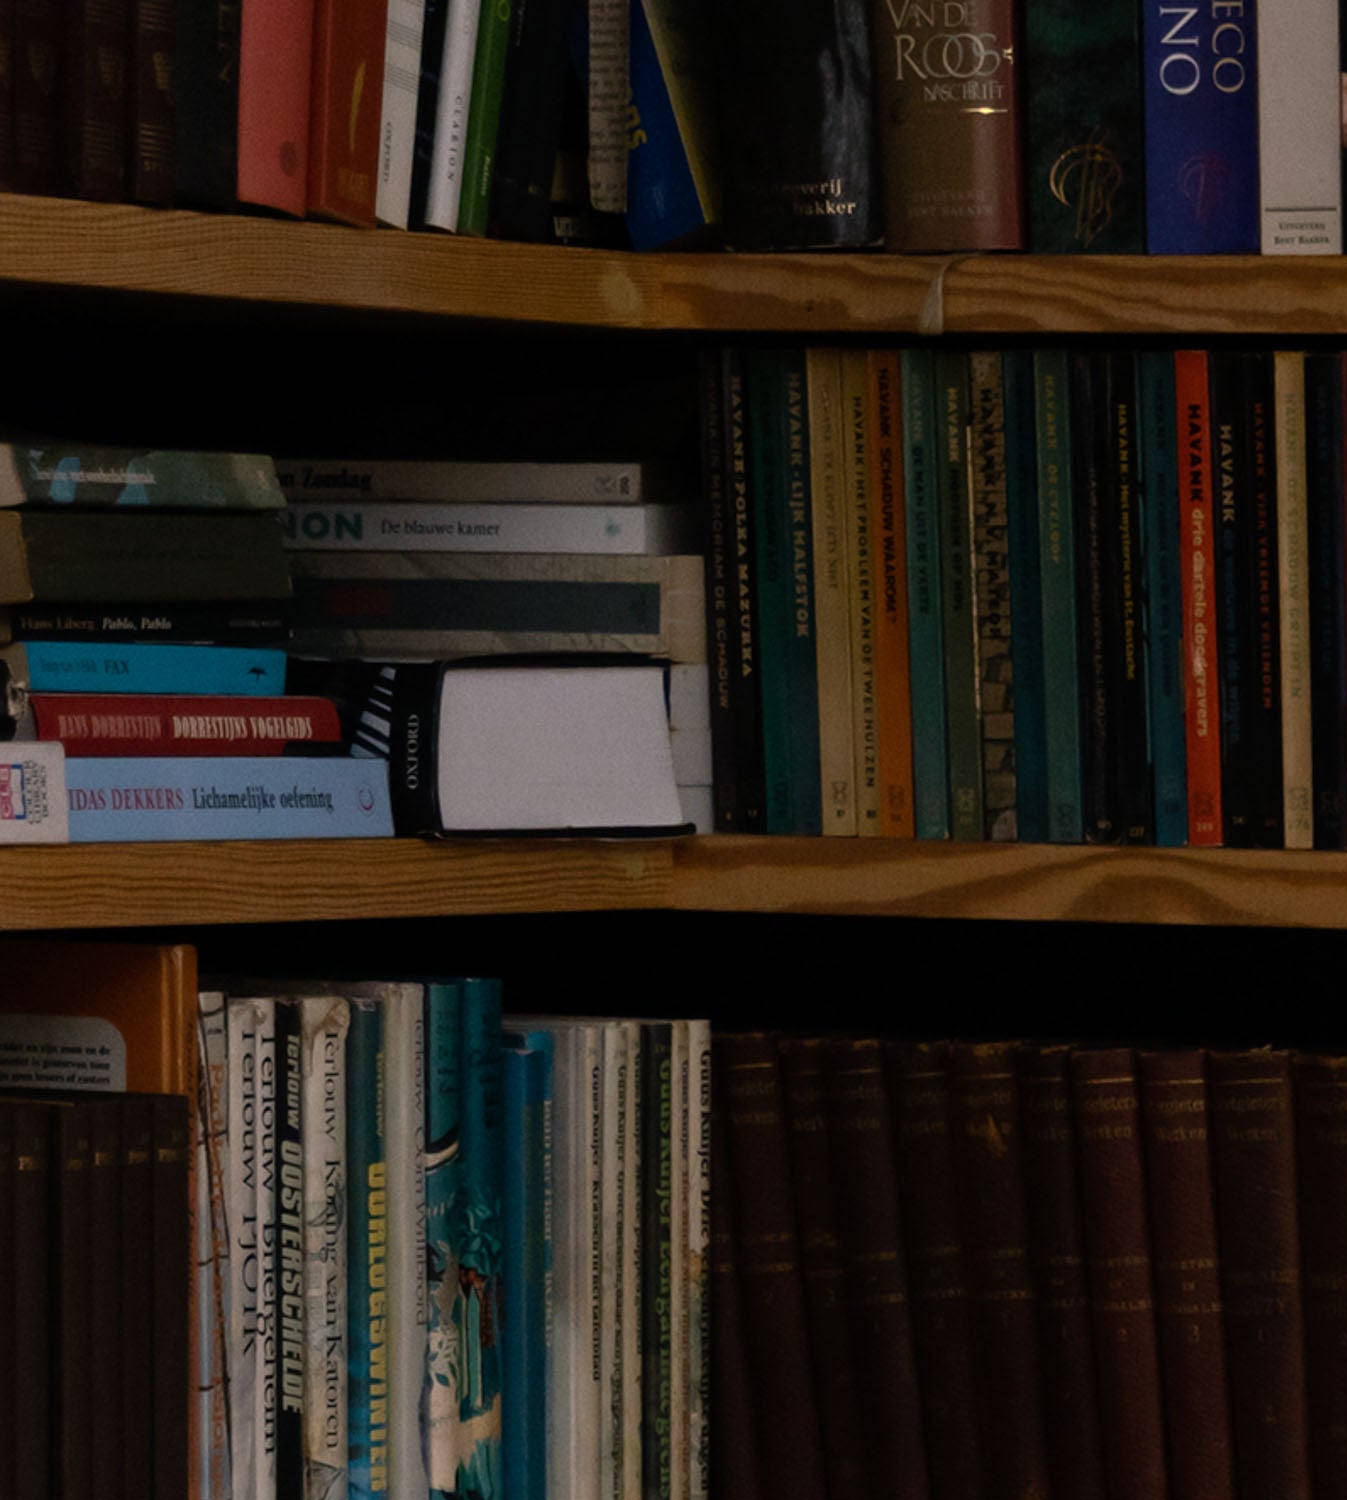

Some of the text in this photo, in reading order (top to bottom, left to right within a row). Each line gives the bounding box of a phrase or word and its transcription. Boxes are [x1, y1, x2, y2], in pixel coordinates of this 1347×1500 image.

[879, 368, 897, 623] HAVANK SCHADUW WAAROM?
[382, 517, 500, 537] De blauwe kamer
[59, 715, 88, 738] HANS
[251, 717, 312, 739] VOGELGIDS
[406, 713, 419, 791] OXFORD
[68, 787, 333, 811] IDAS DEKKERS Lichamelijke oefening
[280, 1034, 304, 1413] Terlouw OOSTERSCHELDE
